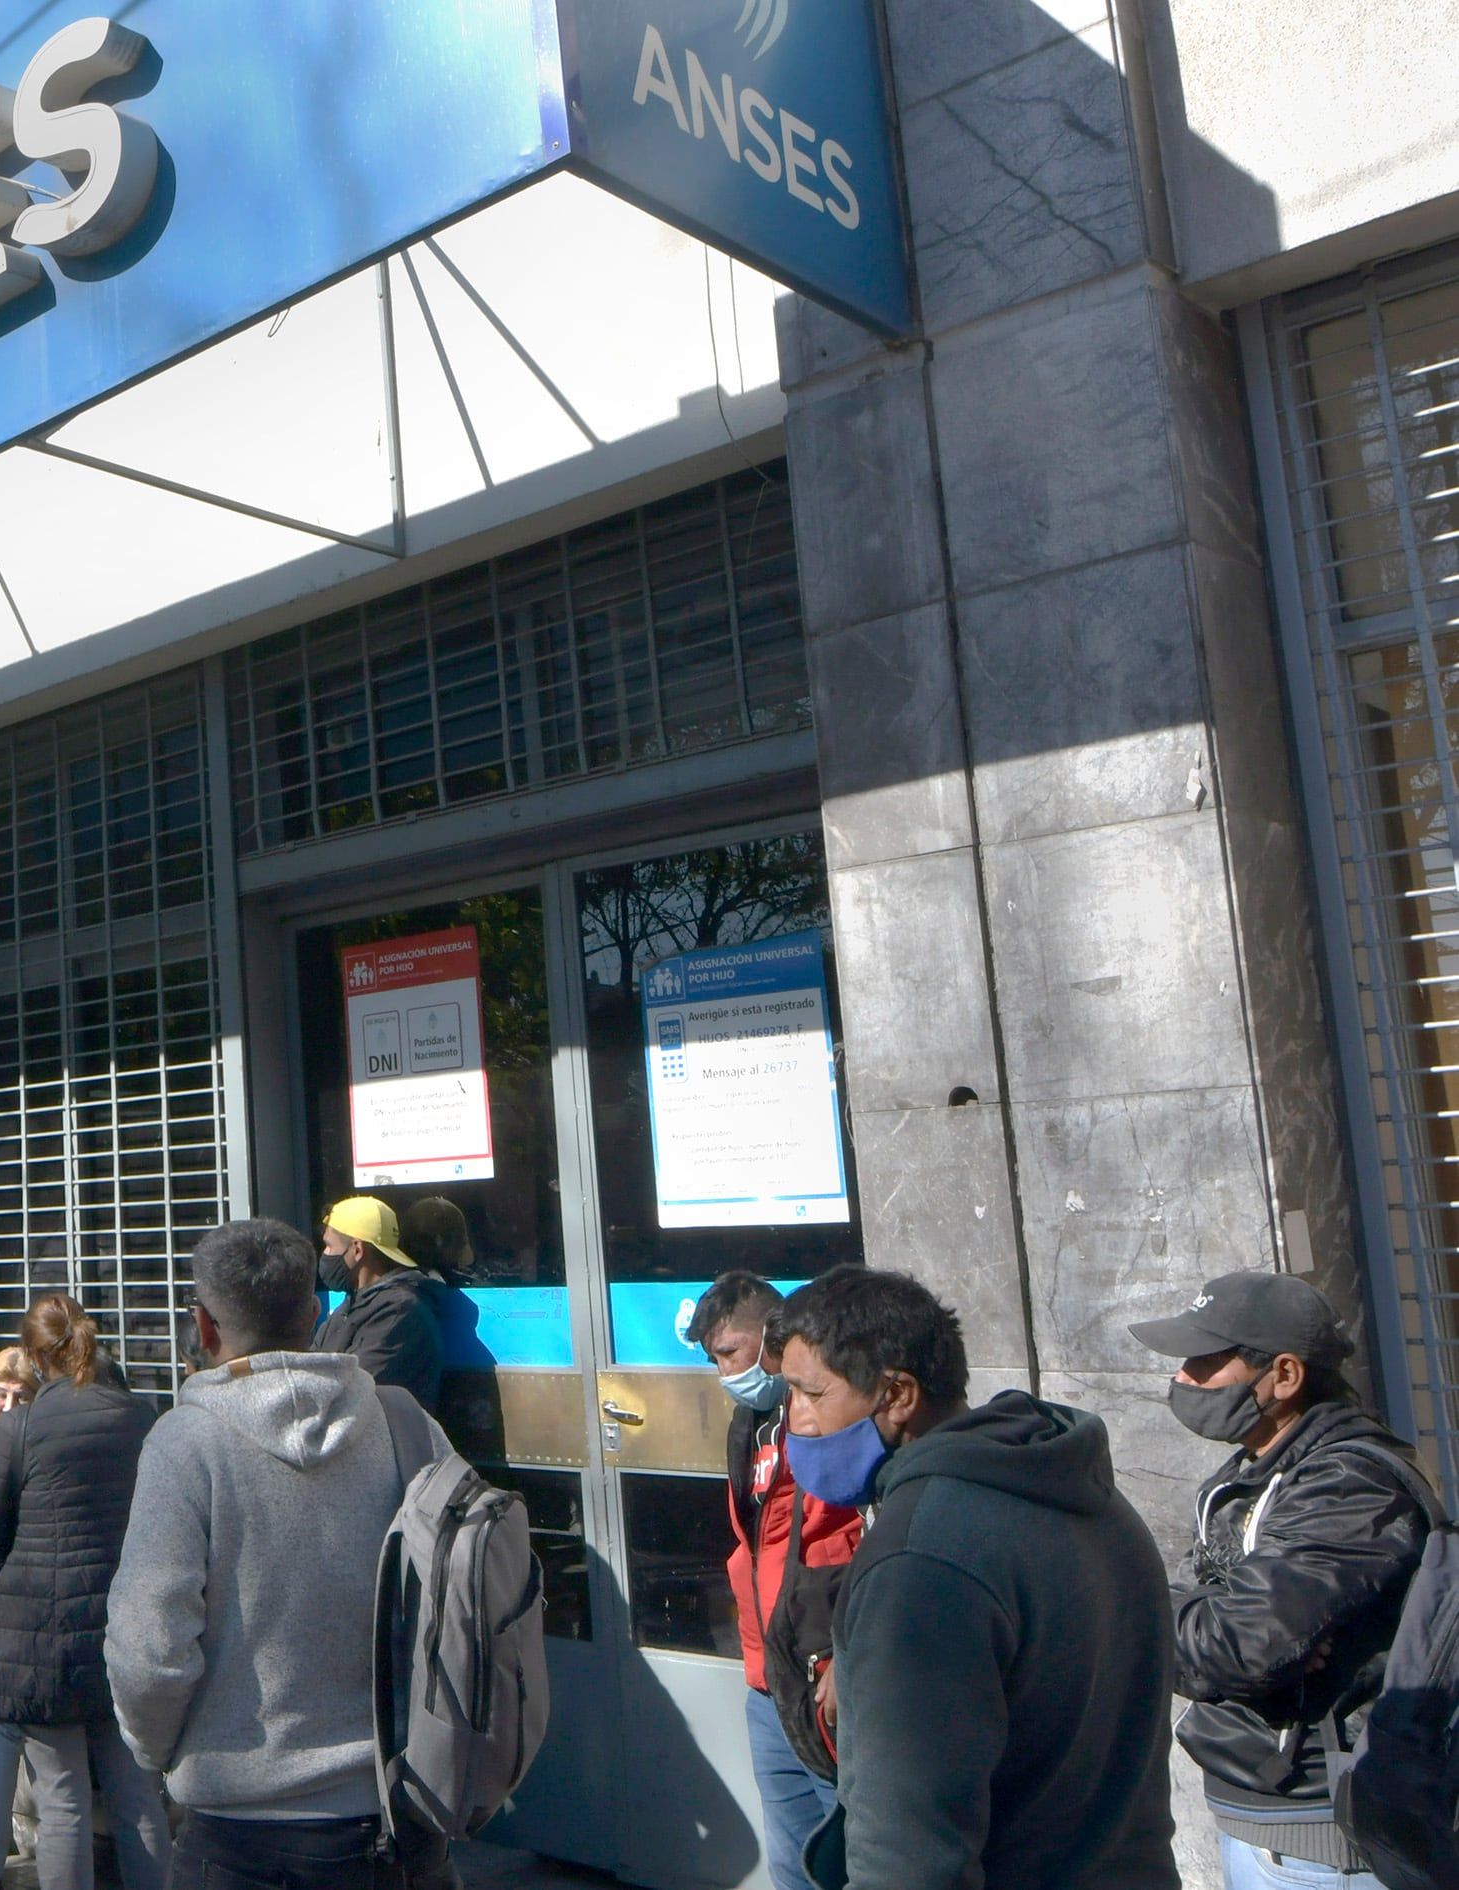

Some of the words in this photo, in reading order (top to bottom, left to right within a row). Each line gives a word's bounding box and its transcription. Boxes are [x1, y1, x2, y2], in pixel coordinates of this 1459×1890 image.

[632, 23, 860, 230] ANSES
[428, 941, 473, 956] UNIVERSAL
[687, 952, 752, 971] ASIGNACIÓN
[755, 945, 815, 962] UNIVERSAL
[379, 966, 394, 976] POR
[396, 962, 414, 973] HIJO
[689, 972, 710, 984] POR
[712, 969, 735, 981] HIJO
[688, 1008, 729, 1022] Averigüe
[731, 1006, 740, 1017] si
[742, 1004, 762, 1016] está
[764, 998, 815, 1015] registrado
[414, 1034, 445, 1047] Partidas
[446, 1034, 457, 1044] de
[698, 1031, 730, 1044] HIJOS
[414, 1048, 458, 1061] Nacimiento
[368, 1052, 398, 1074] DNI
[702, 1067, 746, 1079] Mensaje
[749, 1064, 759, 1075] al
[763, 1060, 798, 1074] 26737
